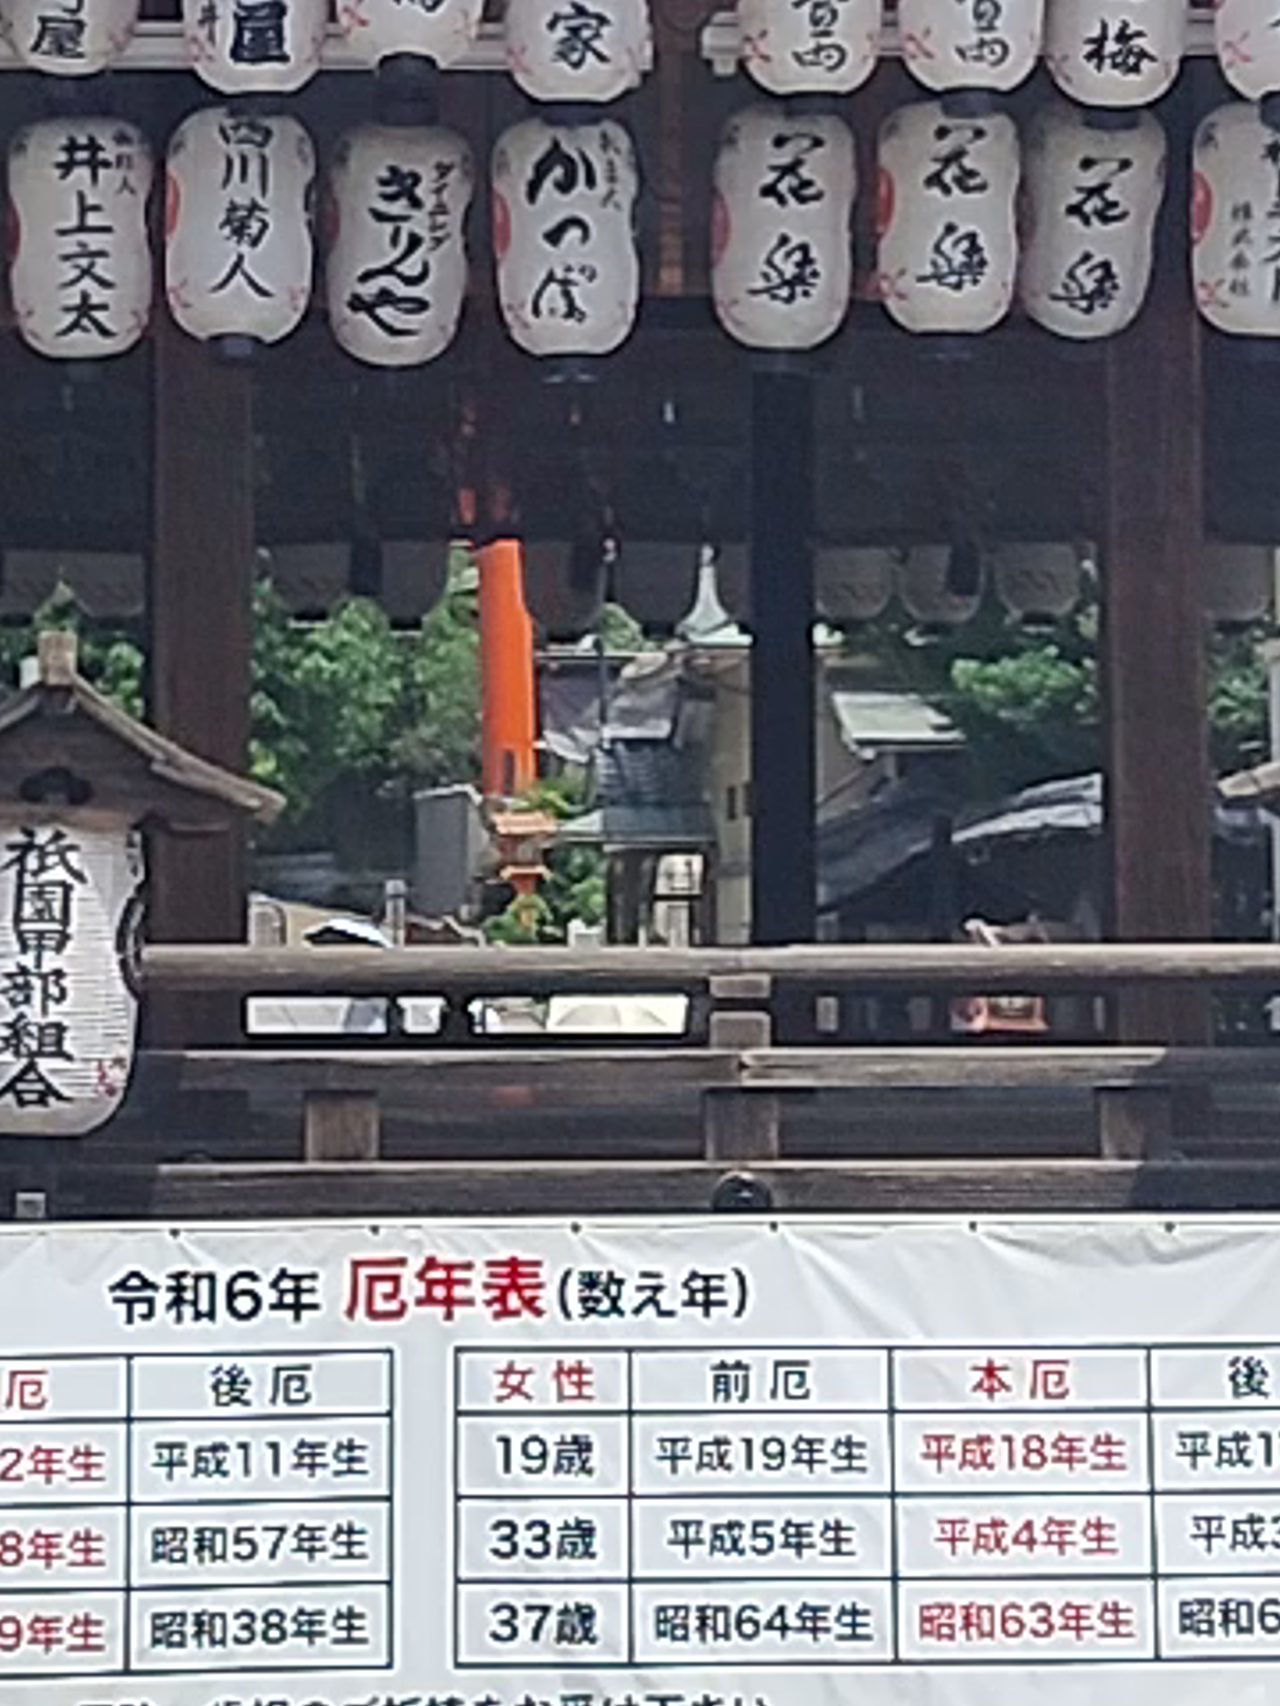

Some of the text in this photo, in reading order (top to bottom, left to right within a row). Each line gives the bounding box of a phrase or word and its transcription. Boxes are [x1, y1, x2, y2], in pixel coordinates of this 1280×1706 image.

[54, 135, 120, 340] 井上文太
[107, 1266, 321, 1326] 令和6年
[150, 1437, 370, 1482] 平成11年生
[495, 1433, 595, 1478] 19歳
[655, 1433, 868, 1476] 平成19年生
[920, 1432, 1128, 1474] 平成18年生
[150, 1520, 369, 1565] 昭和57年生
[489, 1516, 598, 1561] 33歳
[666, 1518, 857, 1560] 平成5年生
[934, 1515, 1119, 1557] 平成4年生
[149, 1604, 370, 1650] 昭和38年生
[488, 1601, 599, 1646] 37歳
[654, 1600, 874, 1645] 昭和64年生
[918, 1600, 1136, 1643] 昭和63年生
